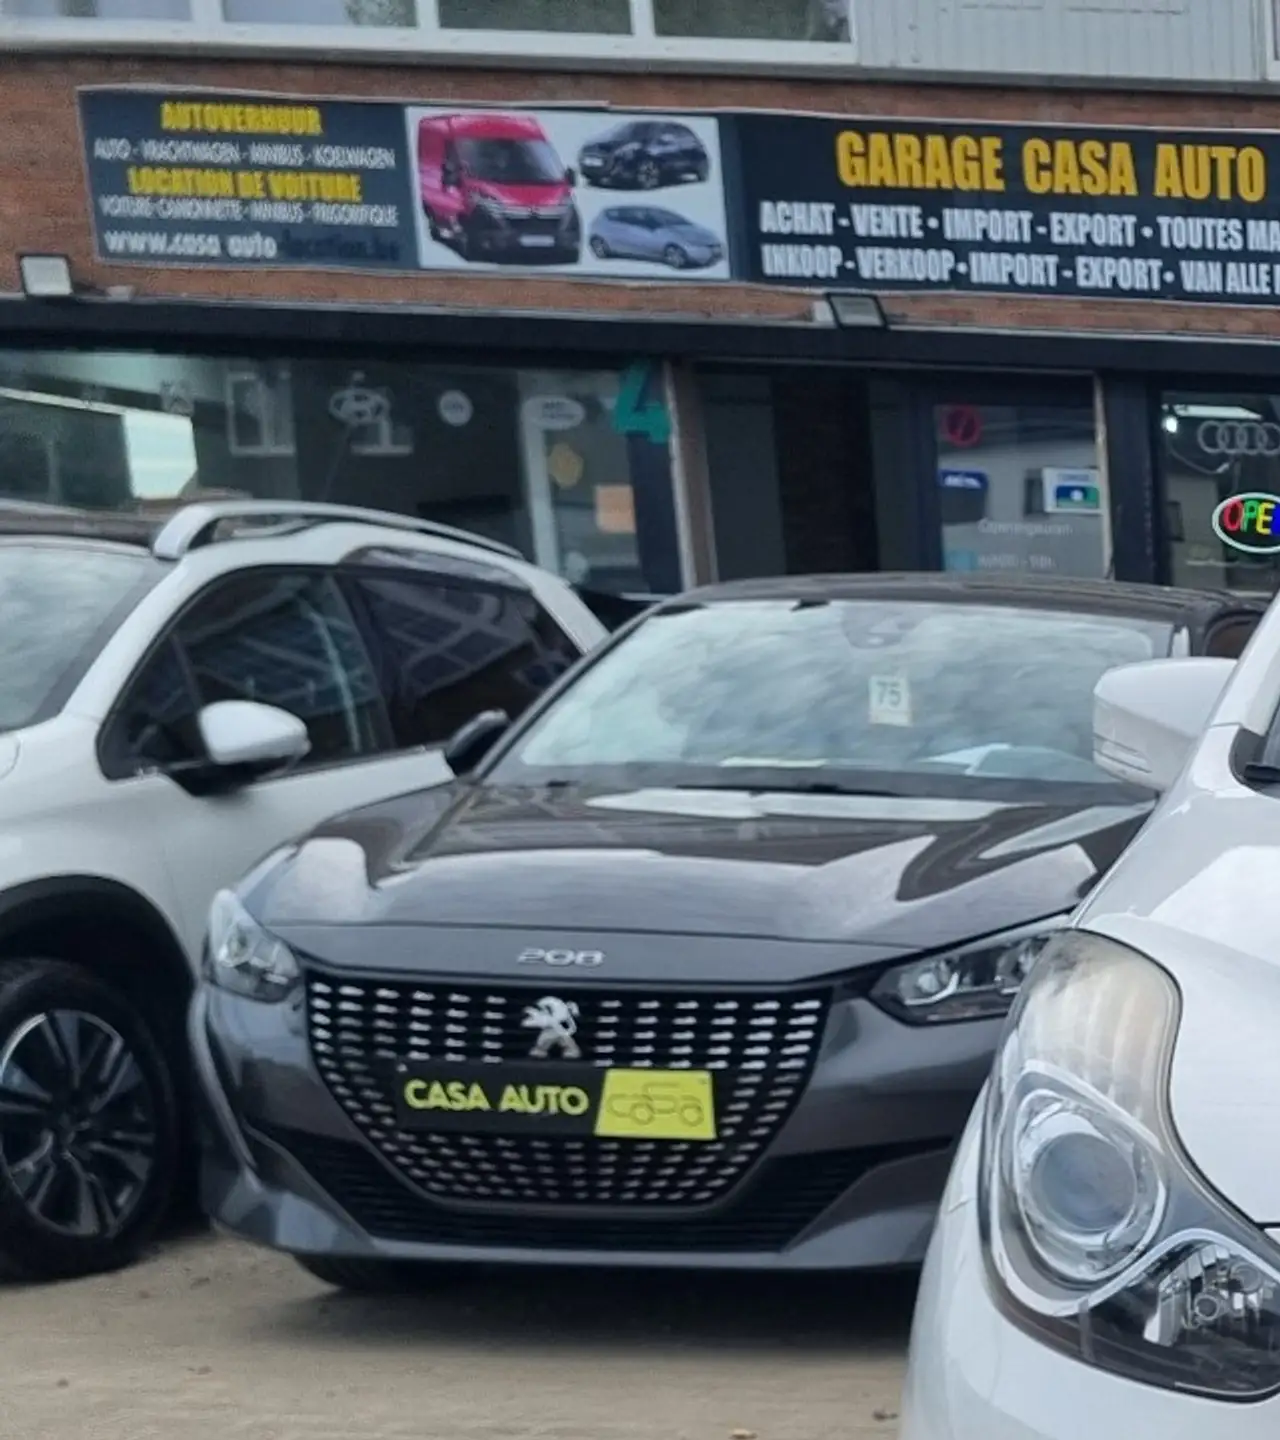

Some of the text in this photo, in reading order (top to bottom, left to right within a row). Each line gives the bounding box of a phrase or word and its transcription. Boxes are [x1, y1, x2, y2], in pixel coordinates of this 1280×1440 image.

[127, 166, 362, 203] LOCATION DE VOITURE
[836, 130, 1266, 203] GARAGE CASA AUTO
[760, 201, 835, 235] ACHAT
[850, 204, 924, 238] VENTE
[942, 208, 1033, 242] IMPORT
[1050, 213, 1137, 248] EXPORT
[1156, 216, 1242, 251] TOUTES
[761, 244, 844, 279] INKOOP
[854, 246, 956, 281] VERKOOP
[968, 251, 1060, 286] IMPORT
[1074, 256, 1163, 290] EXPORT
[1178, 260, 1224, 292] VAN
[1226, 261, 1271, 295] ALLE
[404, 1079, 491, 1111] CASA
[500, 1084, 589, 1115] AUTO
